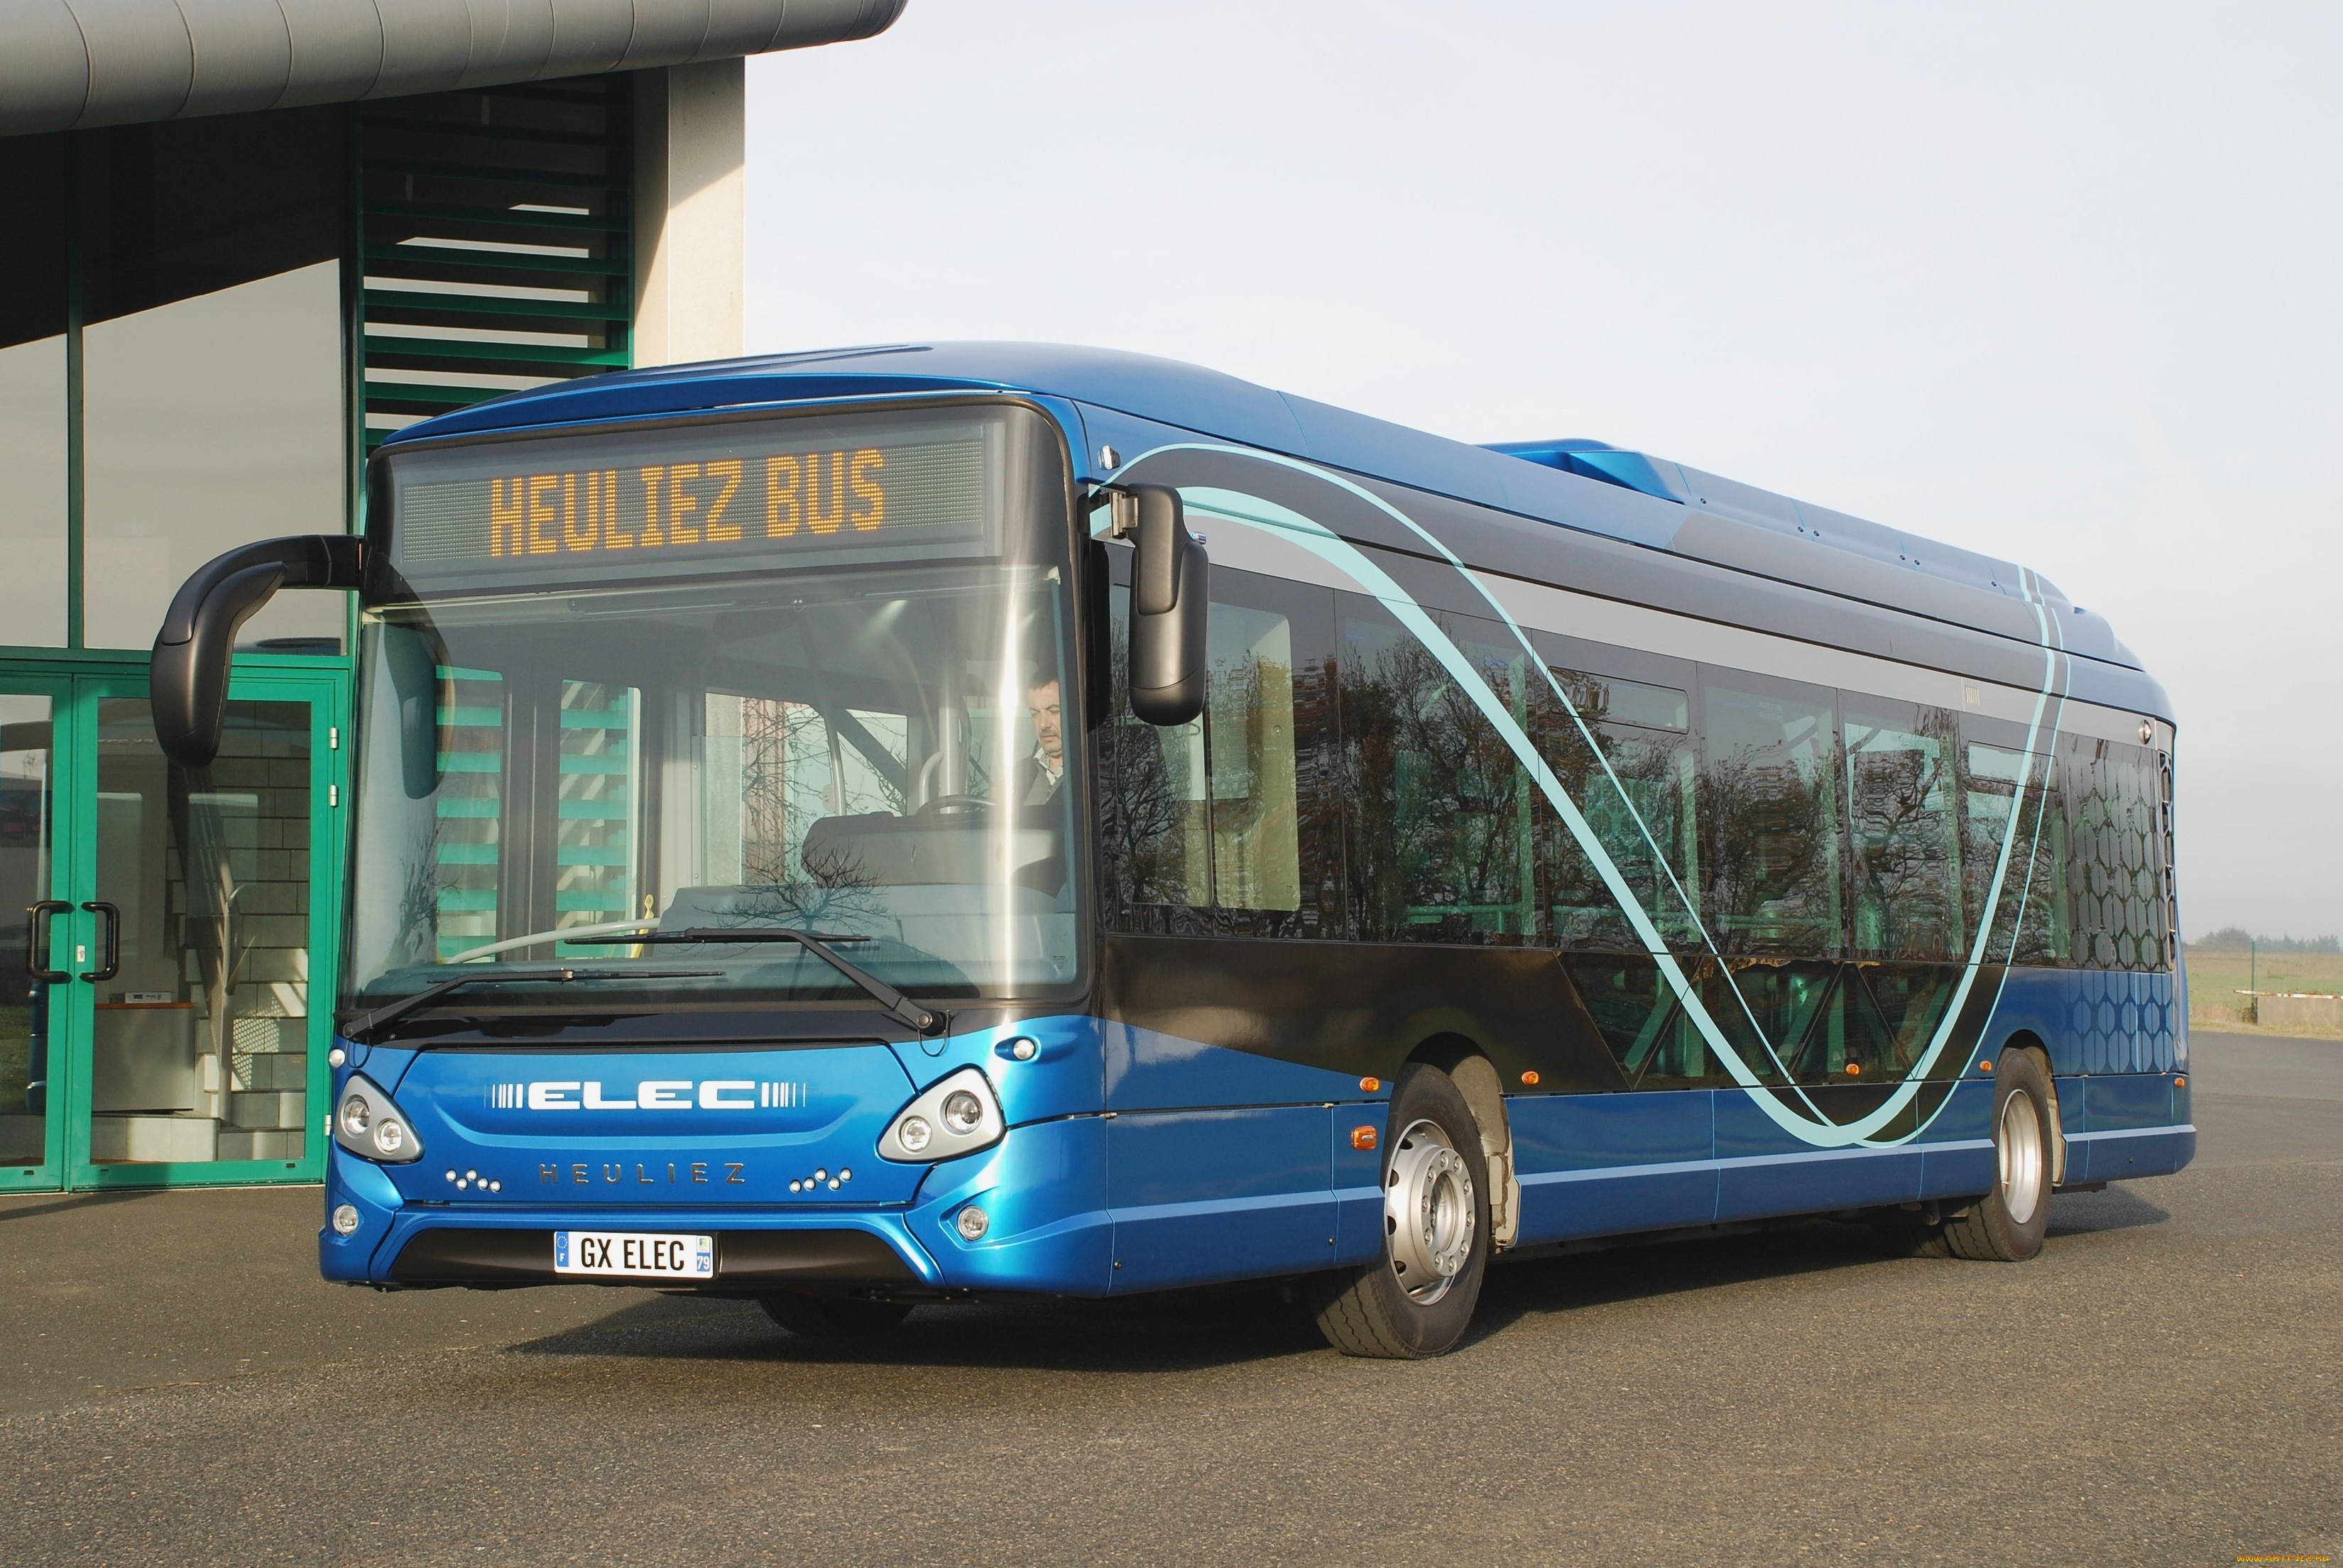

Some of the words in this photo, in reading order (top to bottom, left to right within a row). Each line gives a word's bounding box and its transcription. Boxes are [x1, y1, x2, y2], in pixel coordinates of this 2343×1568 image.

[491, 459, 742, 557] HEULIEZ
[767, 449, 884, 537] BUS
[528, 1080, 755, 1110] ELEC
[539, 1163, 746, 1185] HEULIEZ
[559, 1252, 565, 1262] F
[581, 1237, 613, 1268] GX
[623, 1239, 684, 1271] ELEC
[697, 1255, 710, 1271] 79
